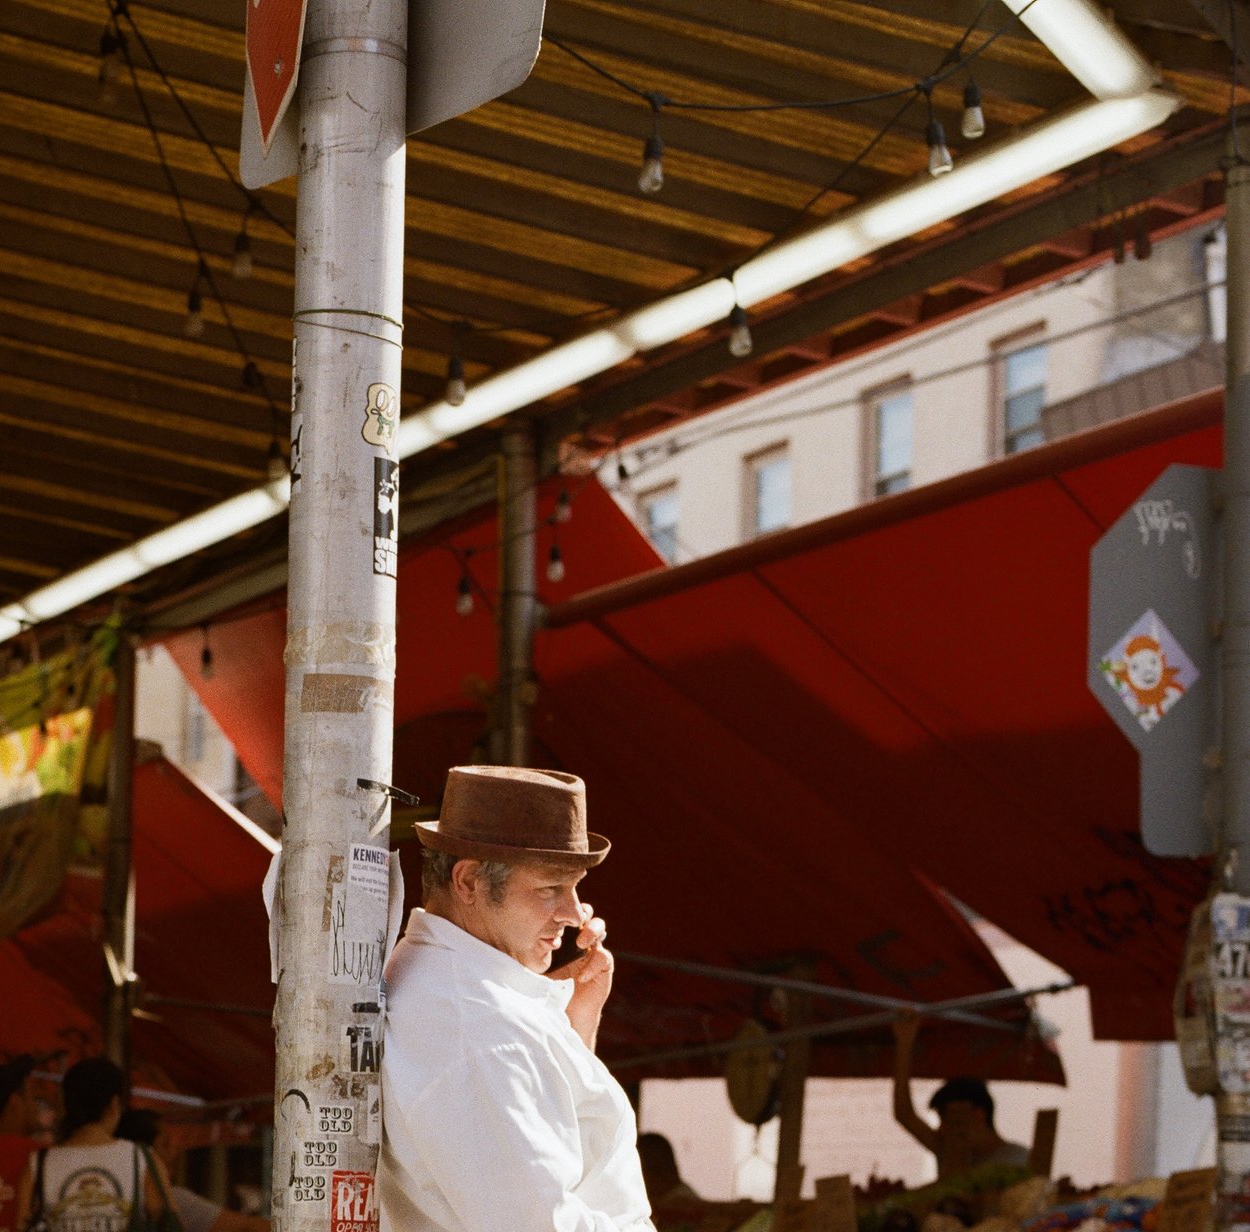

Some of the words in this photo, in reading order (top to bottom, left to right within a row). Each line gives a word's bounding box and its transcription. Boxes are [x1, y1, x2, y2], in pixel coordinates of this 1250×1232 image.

[347, 1026, 380, 1073] TA
[319, 1106, 353, 1119] TOO
[319, 1120, 352, 1132] OLD
[304, 1141, 337, 1154] TOO
[304, 1154, 337, 1167] OLD
[295, 1175, 326, 1188] TOO
[294, 1188, 326, 1201] OLD
[337, 1181, 379, 1222] REA
